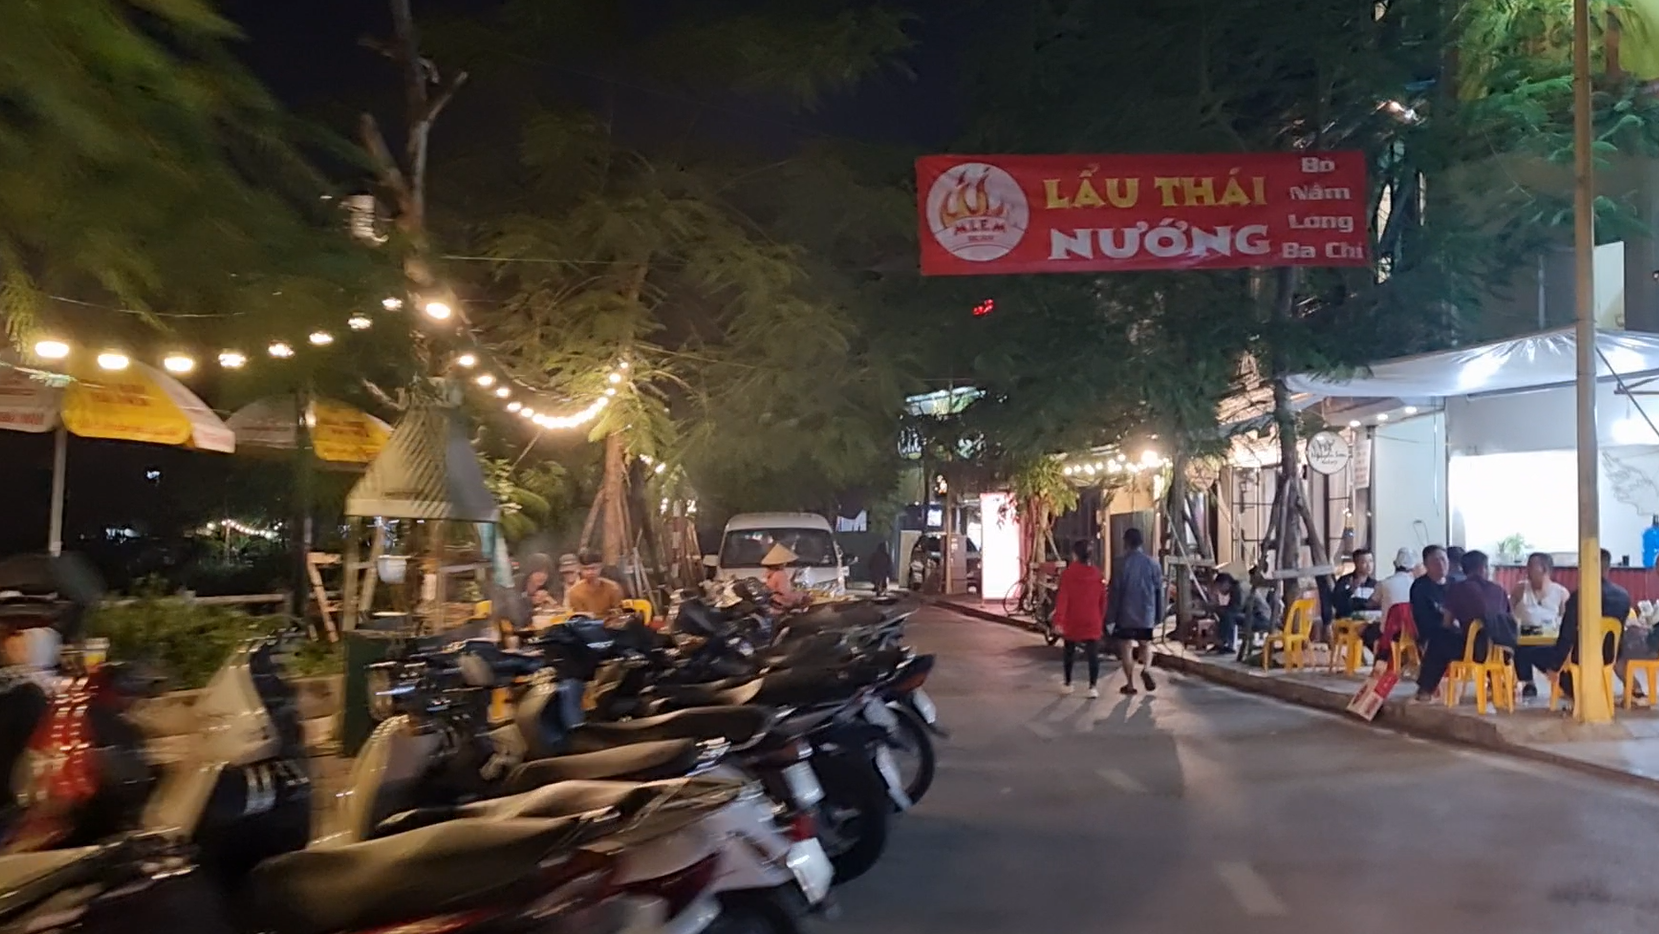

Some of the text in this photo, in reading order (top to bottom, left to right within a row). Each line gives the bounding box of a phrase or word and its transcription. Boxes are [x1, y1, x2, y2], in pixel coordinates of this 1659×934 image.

[1154, 167, 1268, 207] THÁI
[1047, 217, 1271, 260] NƯỚNG
[1282, 242, 1316, 258] Ba
